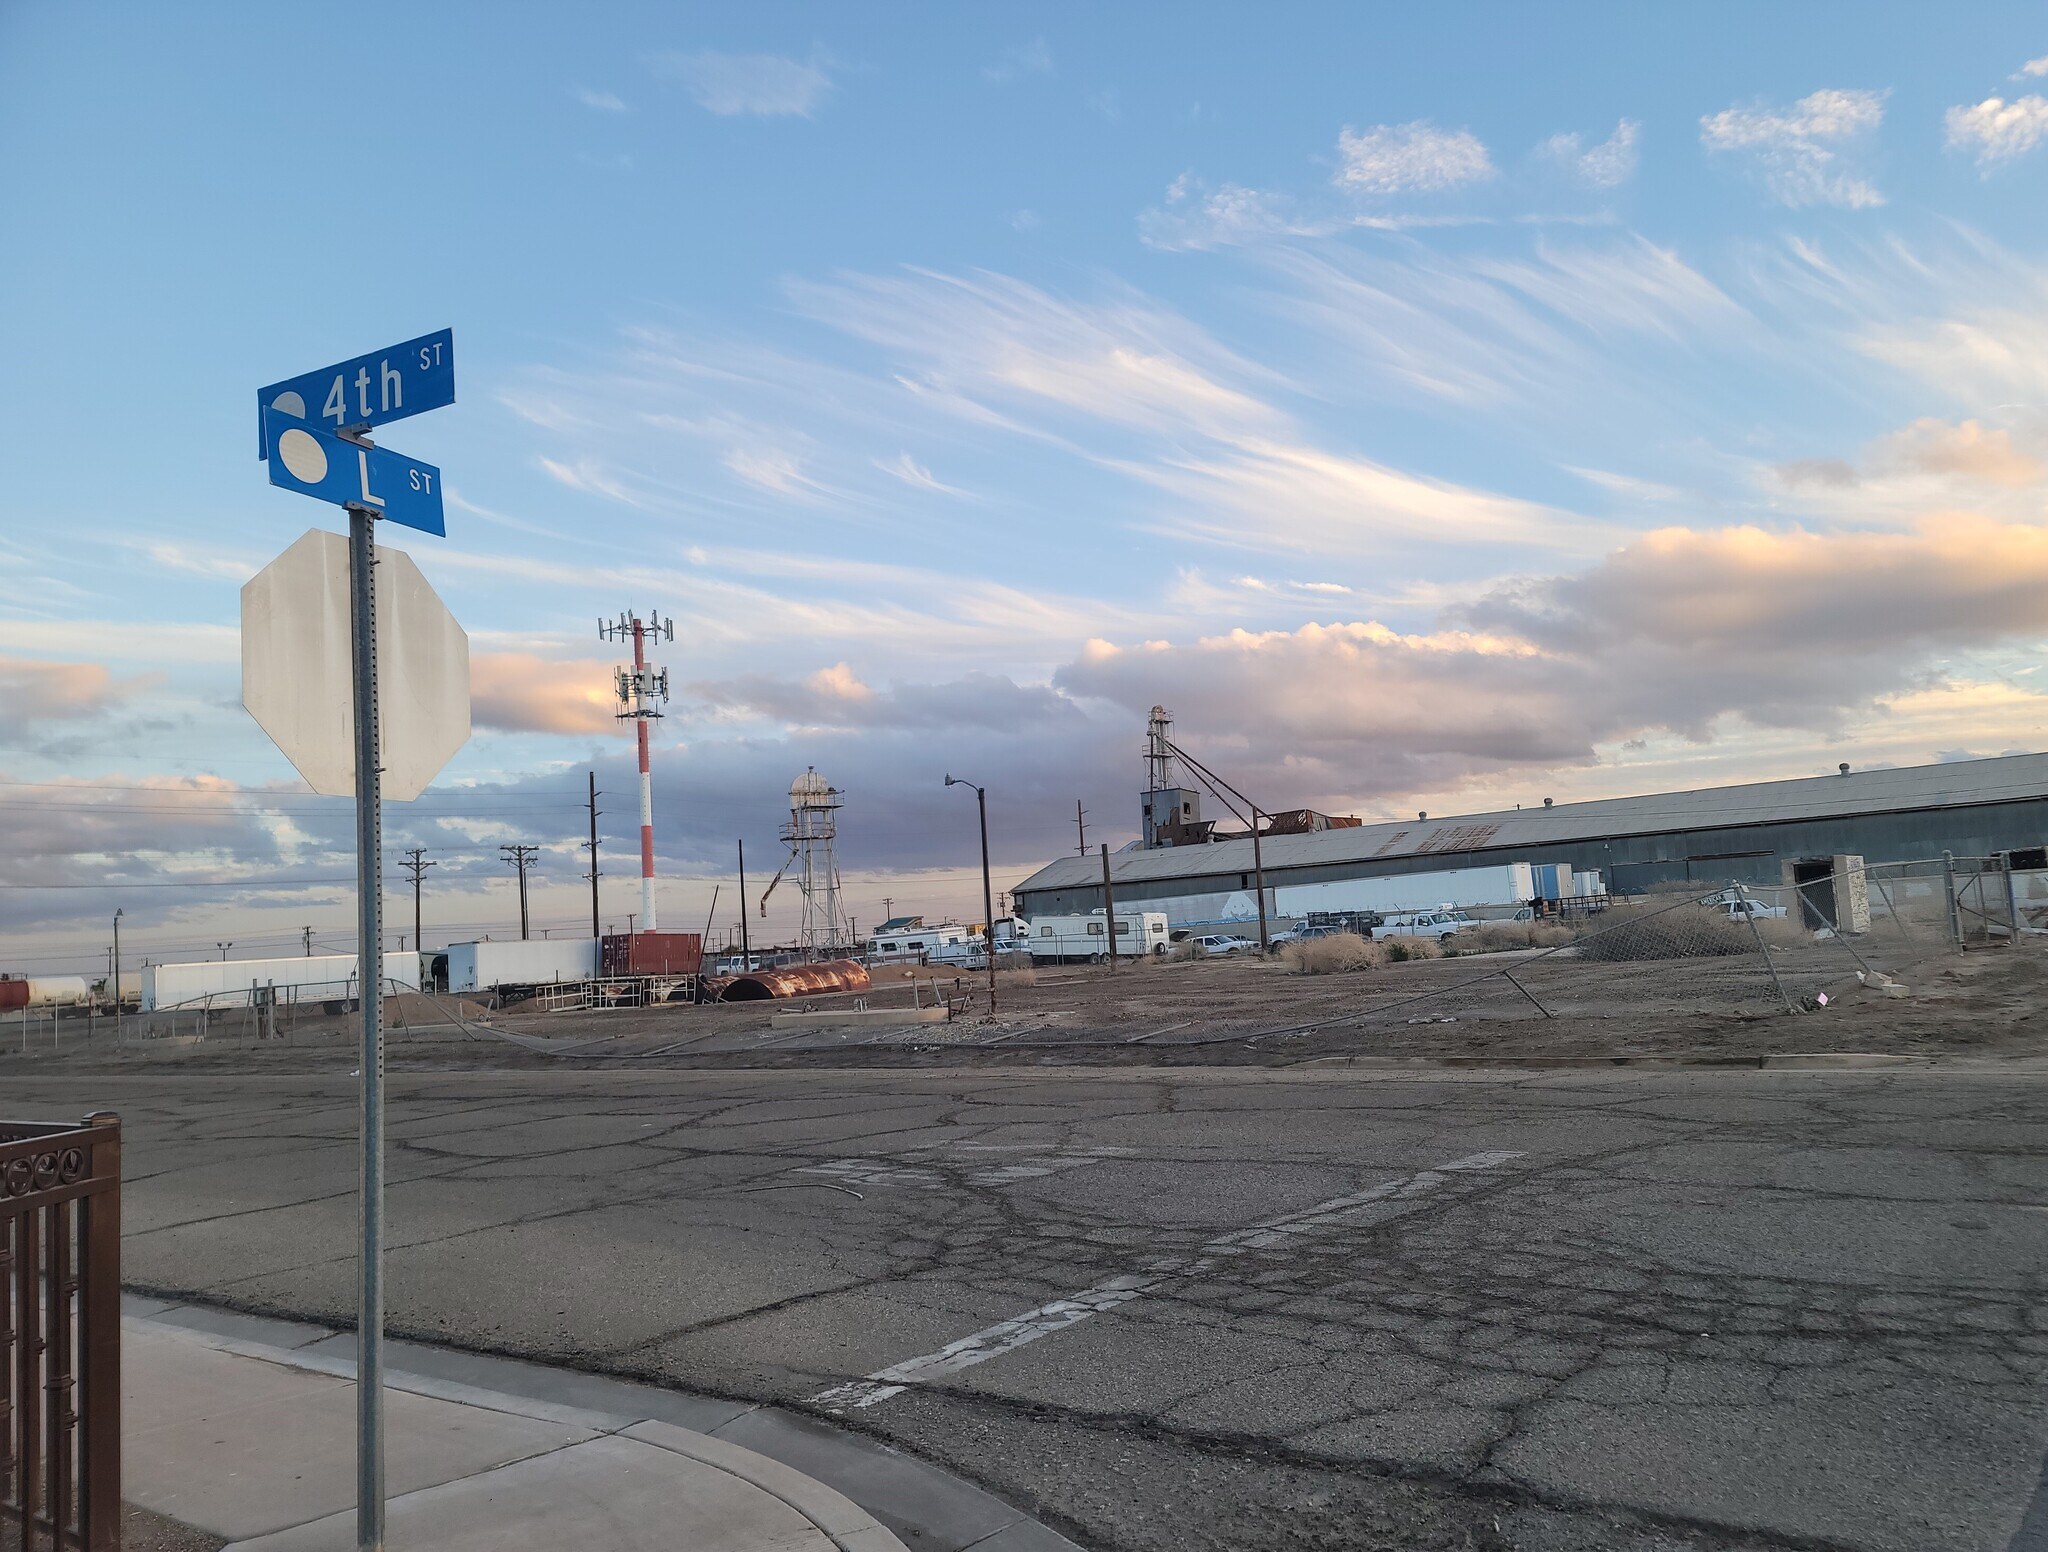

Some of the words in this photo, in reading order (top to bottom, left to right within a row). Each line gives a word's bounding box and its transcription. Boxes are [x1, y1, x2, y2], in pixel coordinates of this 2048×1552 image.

[322, 359, 402, 426] 4th
[419, 342, 443, 371] ST
[358, 450, 386, 507] L
[409, 468, 432, 495] ST
